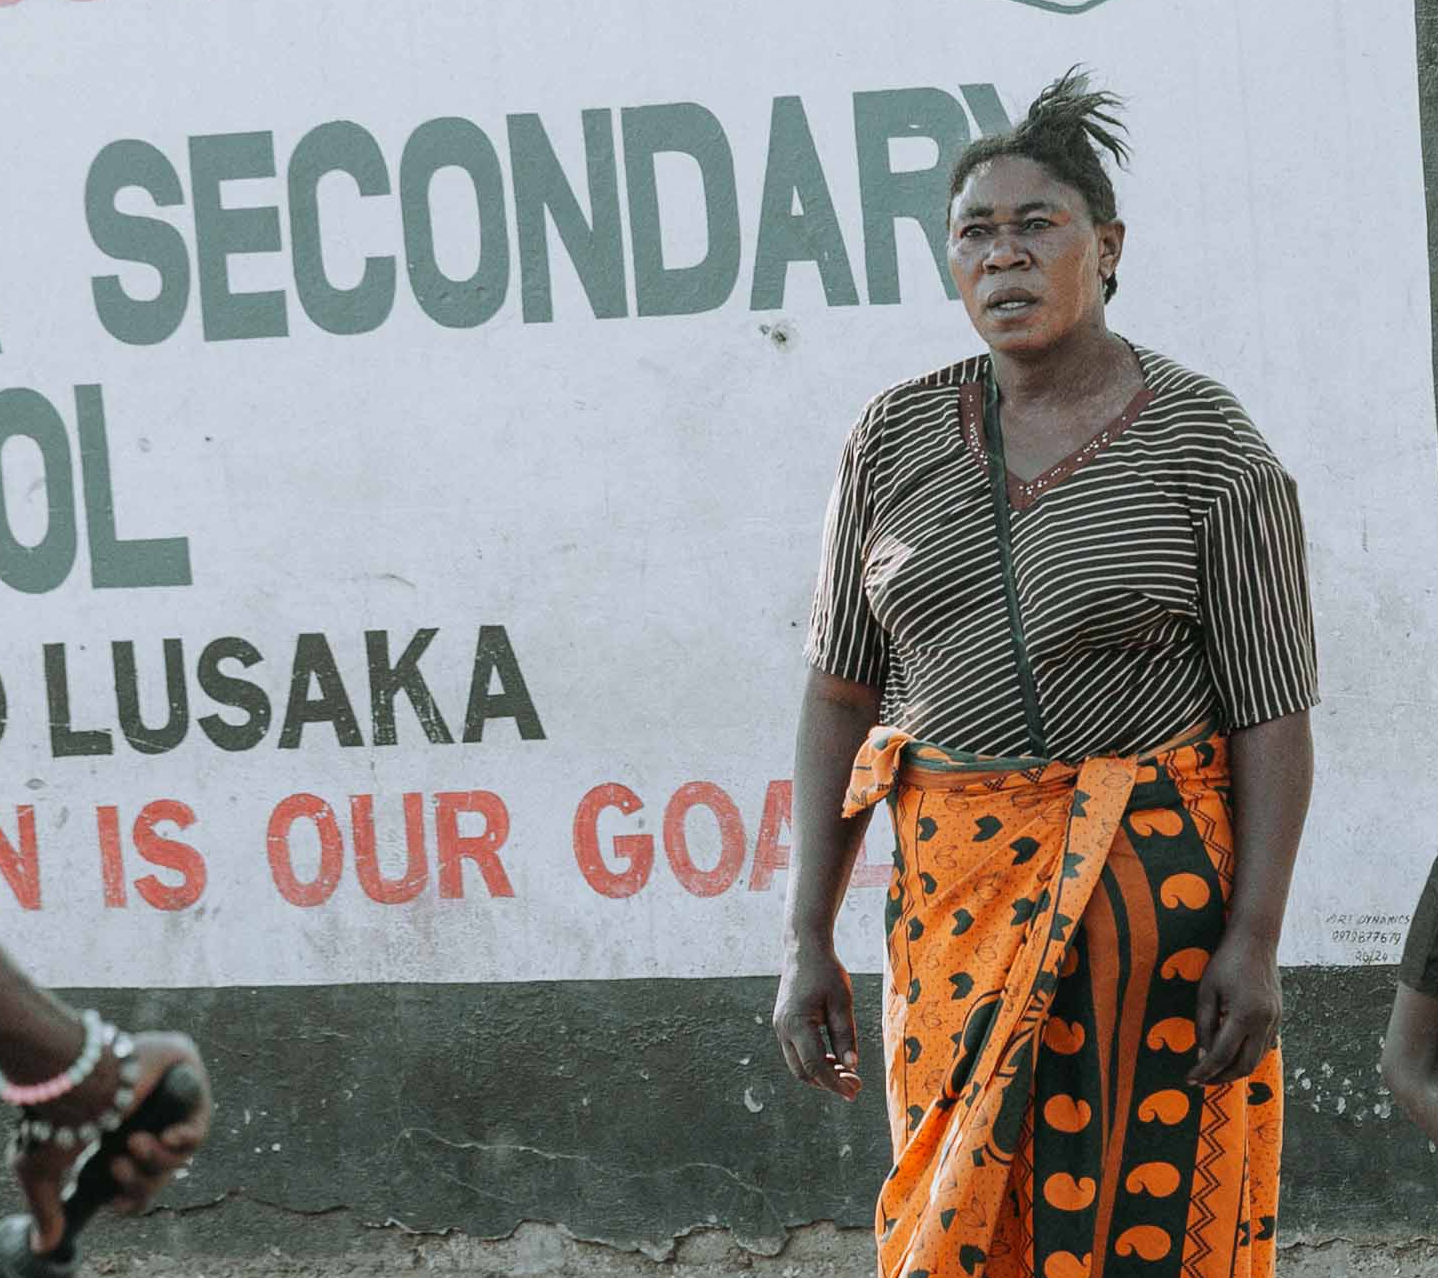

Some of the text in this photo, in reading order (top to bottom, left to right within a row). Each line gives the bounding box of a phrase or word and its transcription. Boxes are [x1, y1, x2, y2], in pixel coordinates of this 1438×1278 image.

[44, 624, 547, 758] LUSAKA
[94, 798, 208, 912] IS
[267, 790, 517, 909] OUR
[572, 779, 893, 899] GO
